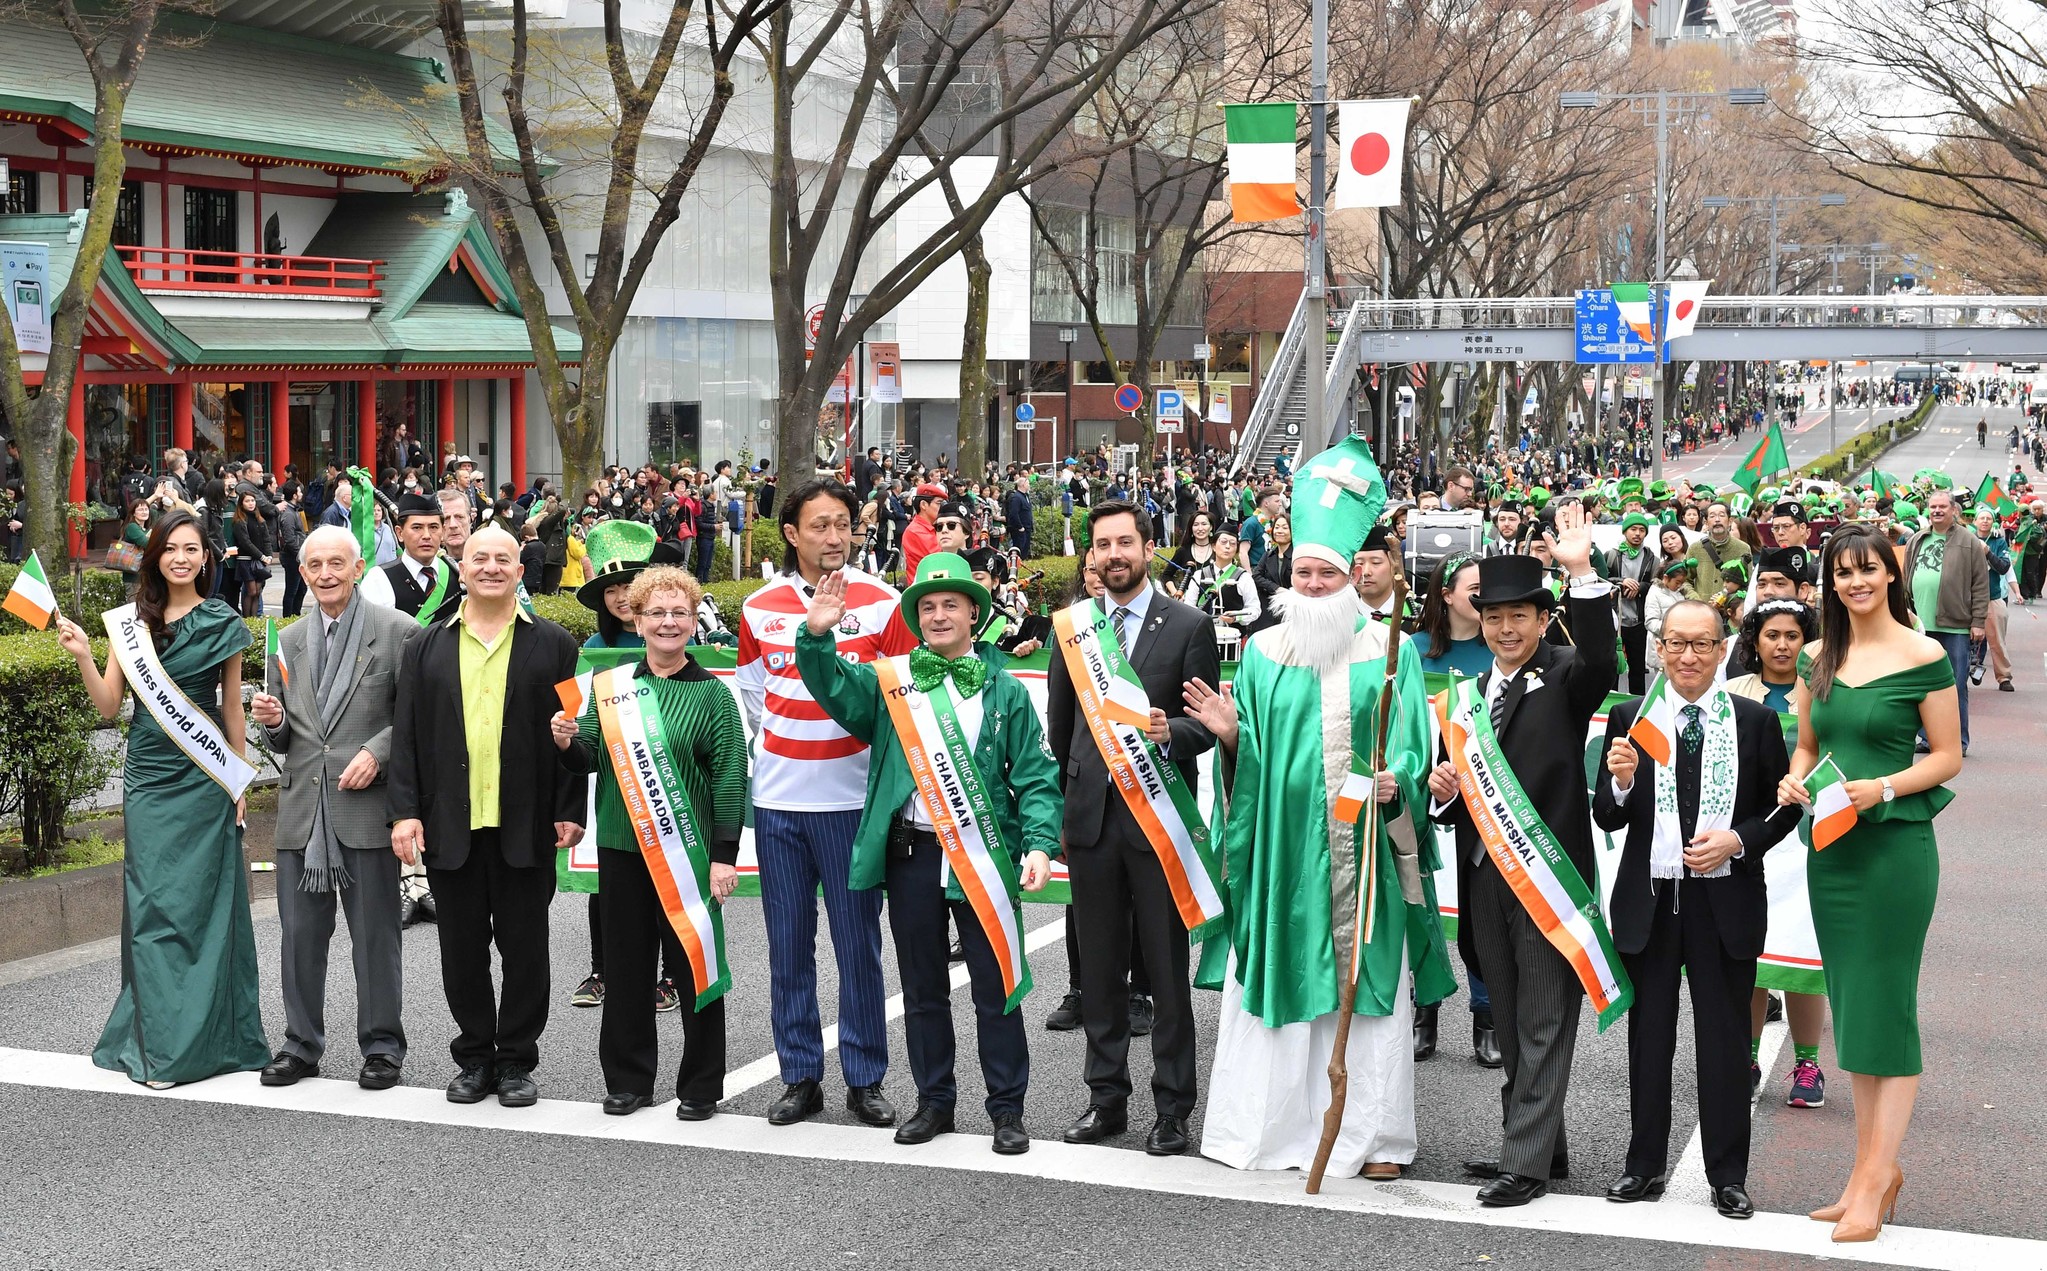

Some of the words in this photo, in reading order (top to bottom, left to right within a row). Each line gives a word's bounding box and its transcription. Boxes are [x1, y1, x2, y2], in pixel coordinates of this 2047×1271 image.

[31, 263, 42, 272] Pay
[1586, 292, 1612, 304] 大原
[1581, 323, 1608, 335] 渋谷
[1160, 392, 1181, 415] P
[1065, 619, 1107, 649] TOKYO
[121, 617, 139, 652] 2017
[134, 656, 158, 692] Miss
[156, 690, 196, 734] World
[190, 730, 227, 768] JAPAN
[601, 687, 650, 708] TOKYO
[888, 682, 918, 700] TOK
[646, 714, 659, 743] SAINT
[940, 713, 957, 740] SAINT
[1082, 690, 1098, 715] IRISH
[1091, 715, 1119, 761] NETWORK
[1112, 761, 1134, 791] JAPAN
[652, 740, 677, 788] PATRICK'S
[952, 744, 980, 792] PATRICK'S
[1123, 733, 1163, 801] MARSHAL
[1155, 751, 1178, 785] ARADE
[612, 742, 628, 769] IRISH
[620, 769, 644, 815] NETWORK
[637, 816, 657, 848] JAPAN
[631, 741, 674, 837] AMBASSADOR
[670, 790, 685, 811] DAY
[909, 746, 926, 773] IRISH
[919, 774, 945, 818] NETWORK
[938, 822, 958, 853] JAPAN
[934, 752, 972, 829] CHAIRMAN
[973, 793, 988, 813] DAY
[1480, 732, 1497, 758] SAINT
[1492, 761, 1522, 807] PATRICK'S
[1518, 808, 1536, 828] DAY
[1531, 829, 1562, 866] PARADE
[1460, 771, 1476, 797] IRISH
[1471, 798, 1498, 840] NETWORK
[1493, 841, 1517, 872] JAPAN
[1470, 752, 1495, 799] GRAND
[1492, 802, 1538, 868] MARSHAL
[678, 812, 698, 849] PARADE
[980, 815, 1000, 850] PARADE
